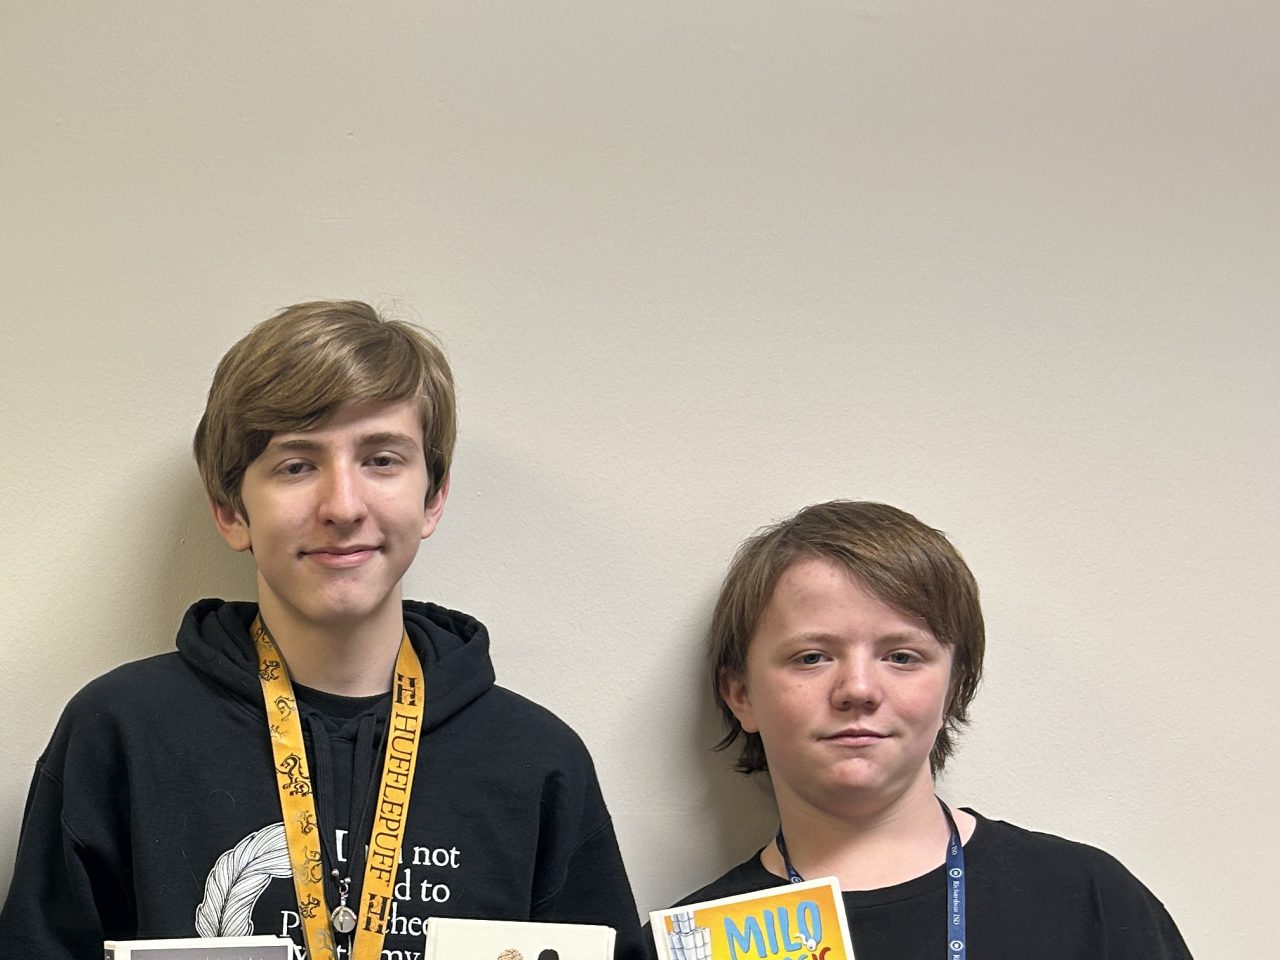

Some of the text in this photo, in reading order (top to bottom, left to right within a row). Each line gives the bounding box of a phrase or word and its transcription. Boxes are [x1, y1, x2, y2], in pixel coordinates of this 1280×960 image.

[370, 713, 419, 888] HUFFLEPUFF
[412, 845, 461, 869] not
[420, 879, 451, 903] to
[952, 880, 960, 926] Richardson ISD
